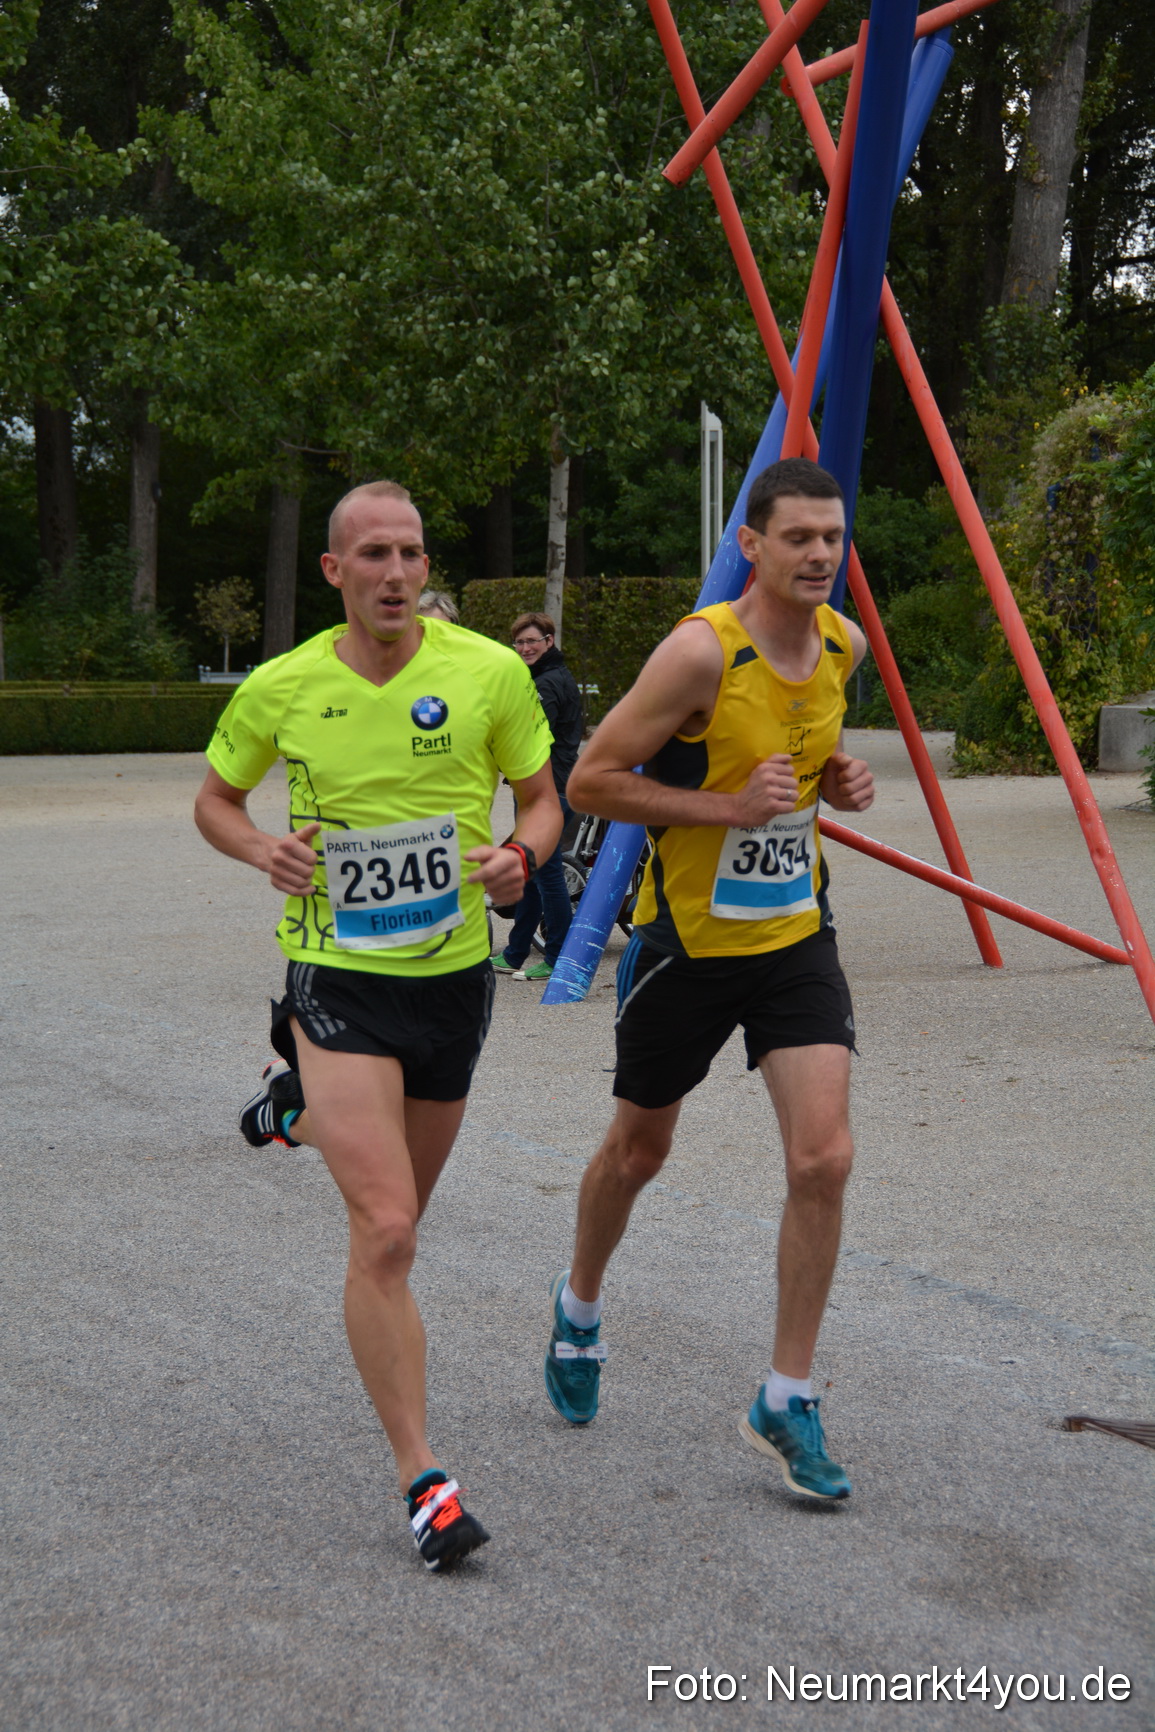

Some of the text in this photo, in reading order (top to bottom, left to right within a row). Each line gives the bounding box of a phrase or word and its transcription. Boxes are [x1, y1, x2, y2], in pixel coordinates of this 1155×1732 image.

[412, 733, 452, 750] Partl
[412, 747, 452, 758] Neumarkt
[732, 824, 769, 834] ARTL
[326, 831, 435, 853] PARTL Neumarkt
[732, 835, 810, 876] 3054
[340, 847, 451, 905] 2346
[371, 909, 432, 931] Florian
